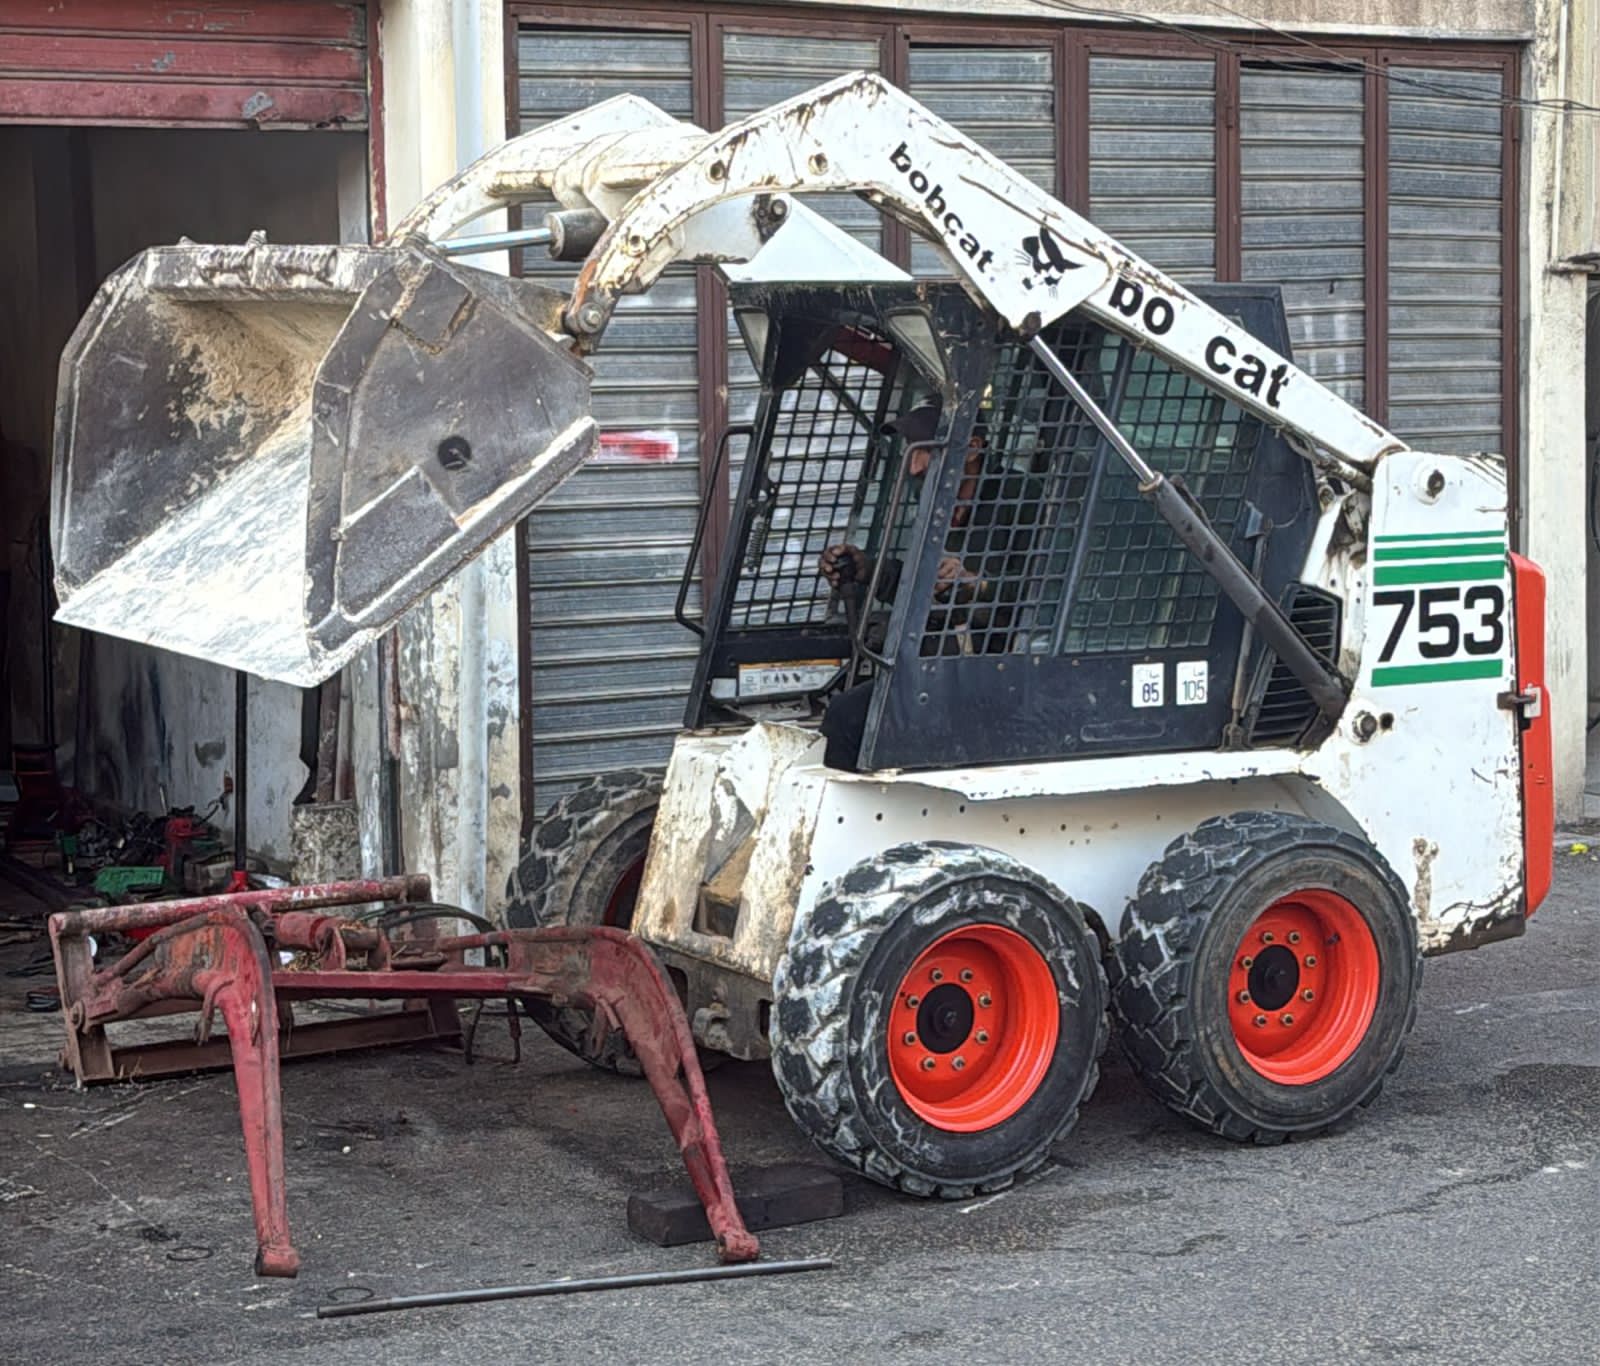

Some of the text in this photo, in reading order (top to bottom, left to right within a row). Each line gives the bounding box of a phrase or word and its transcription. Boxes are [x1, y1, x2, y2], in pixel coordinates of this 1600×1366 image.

[889, 141, 994, 273] bobcat
[1205, 336, 1289, 408] cat
[1373, 585, 1504, 663] 753
[1142, 682, 1160, 703] 85
[1183, 680, 1205, 701] 105
